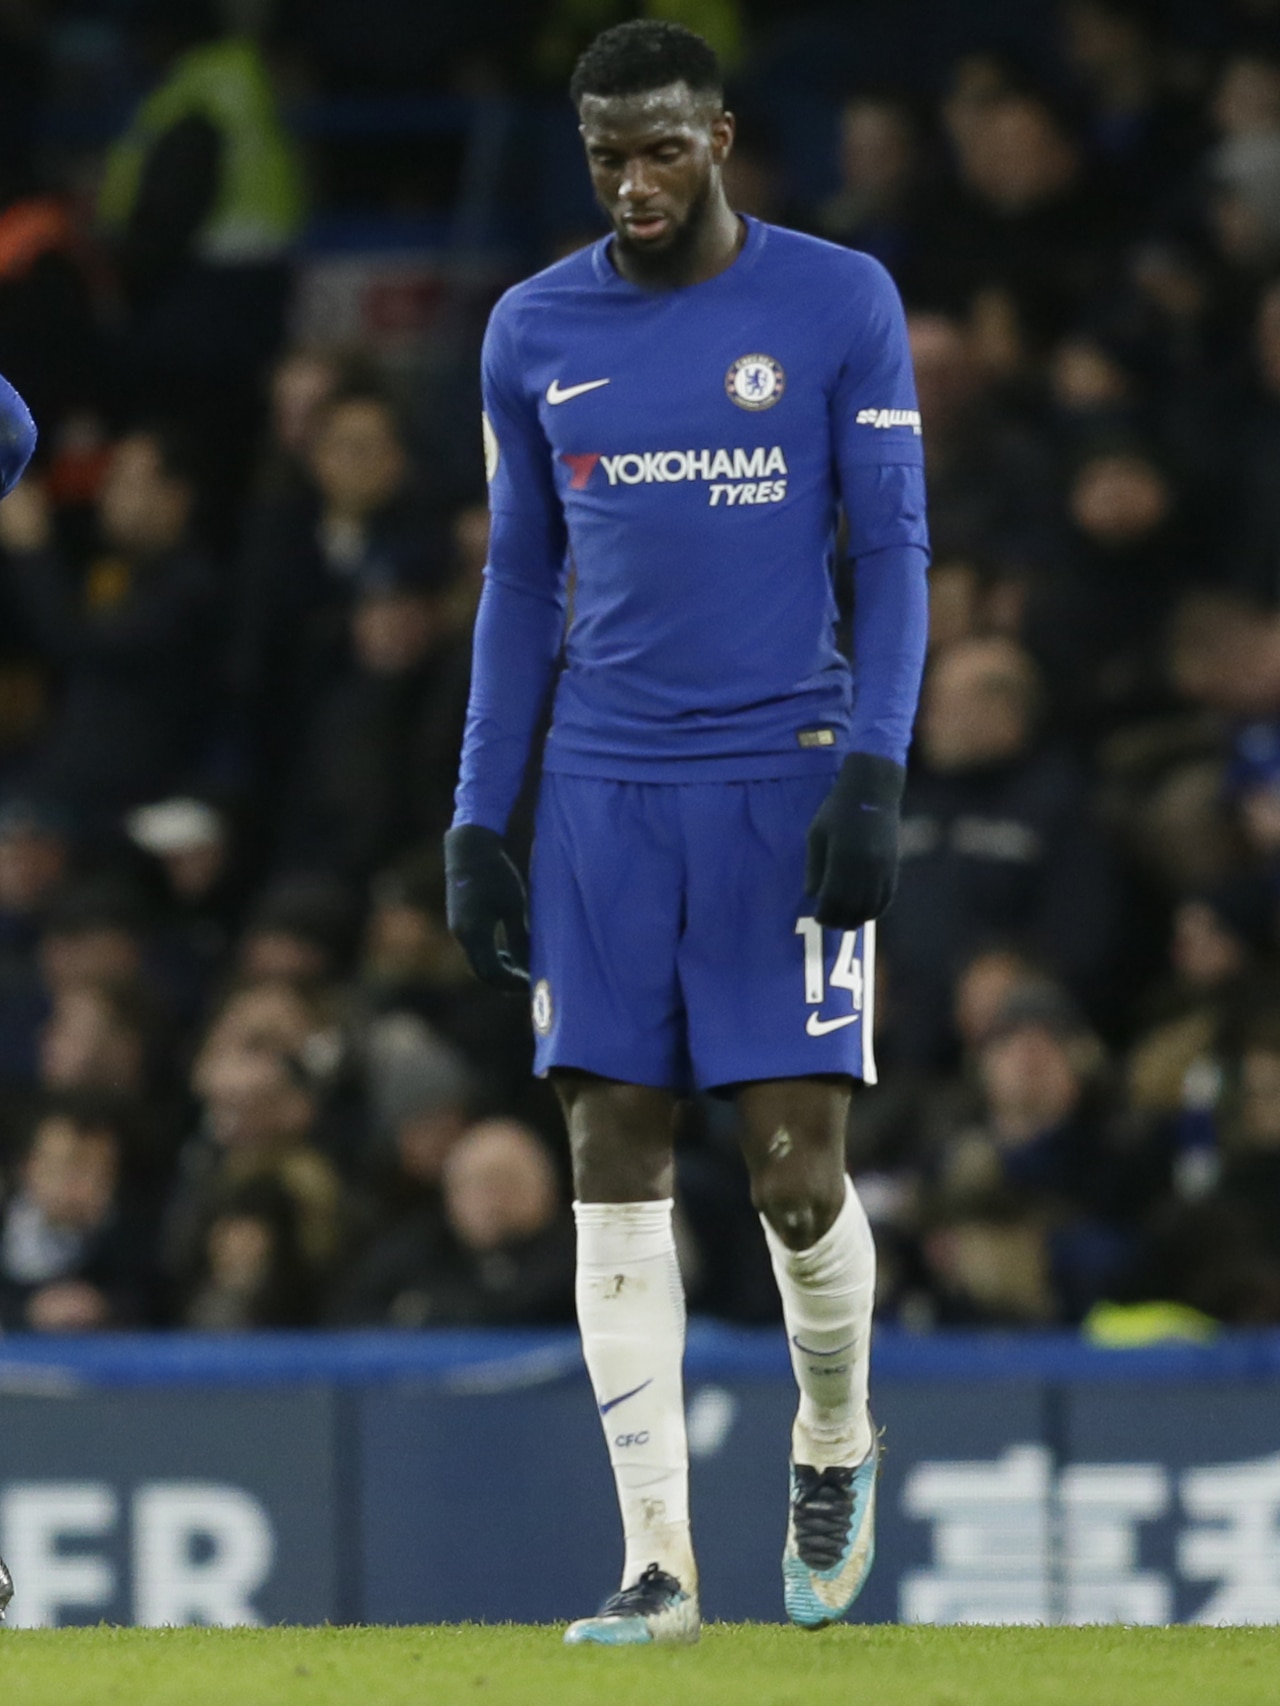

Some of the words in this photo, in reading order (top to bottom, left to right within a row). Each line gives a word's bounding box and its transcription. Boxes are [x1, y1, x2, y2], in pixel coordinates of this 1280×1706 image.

[599, 446, 788, 486] YOKOHAMA
[709, 479, 788, 507] TYRES
[795, 916, 863, 1011] 14
[614, 1430, 649, 1448] CFC
